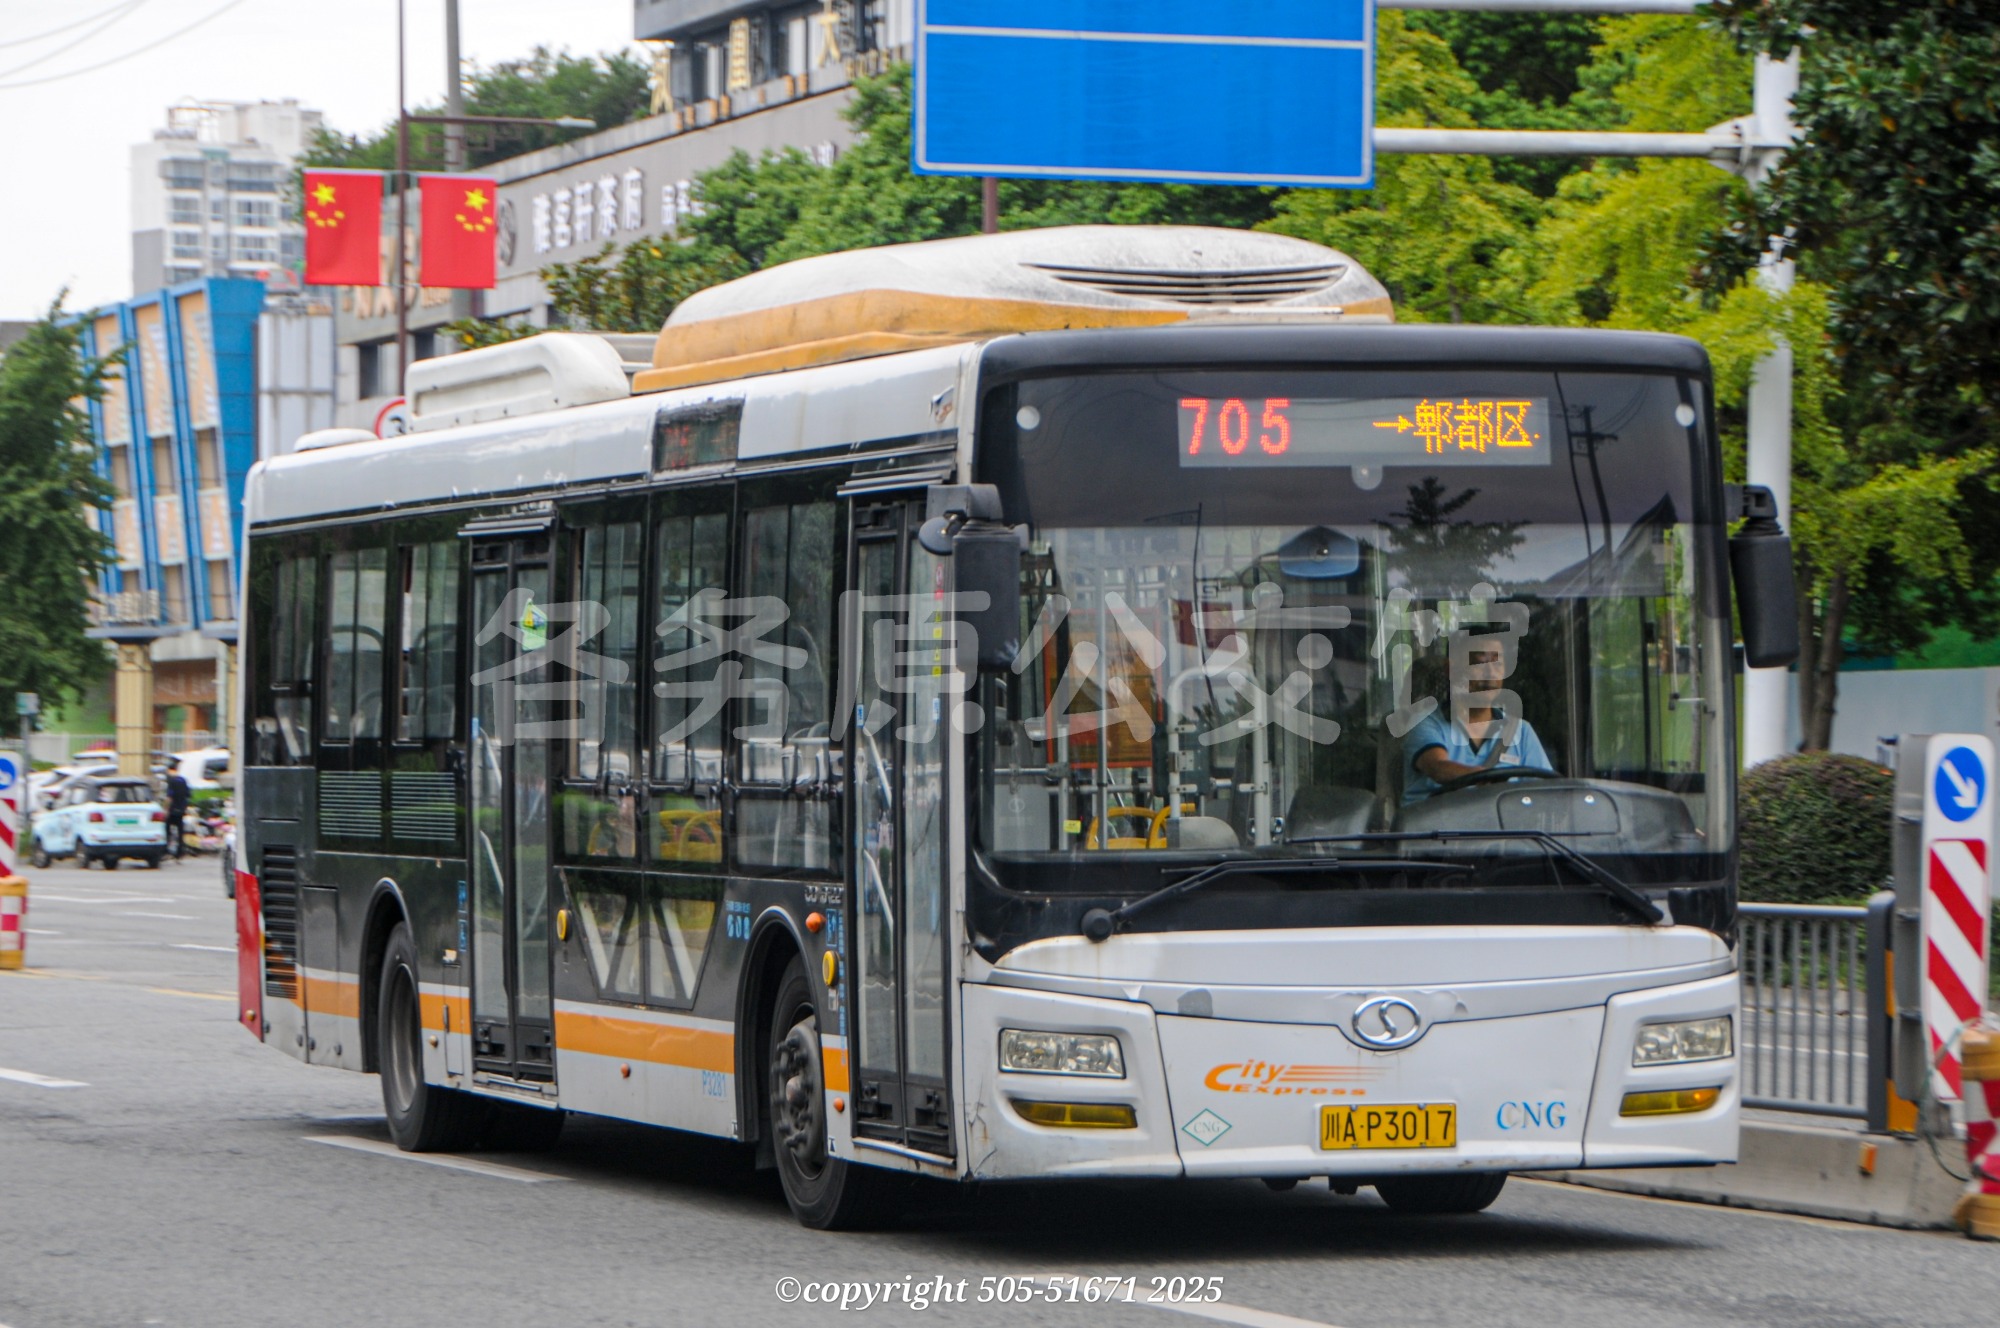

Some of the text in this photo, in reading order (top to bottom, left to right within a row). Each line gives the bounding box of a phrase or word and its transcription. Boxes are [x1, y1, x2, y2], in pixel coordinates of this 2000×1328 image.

[1181, 398, 1291, 455] 705
[1413, 398, 1534, 453] 郫都区
[1204, 1059, 1286, 1092] City
[1232, 1083, 1367, 1096] Express
[1193, 1120, 1221, 1135] CNG
[1496, 1100, 1566, 1131] CNG
